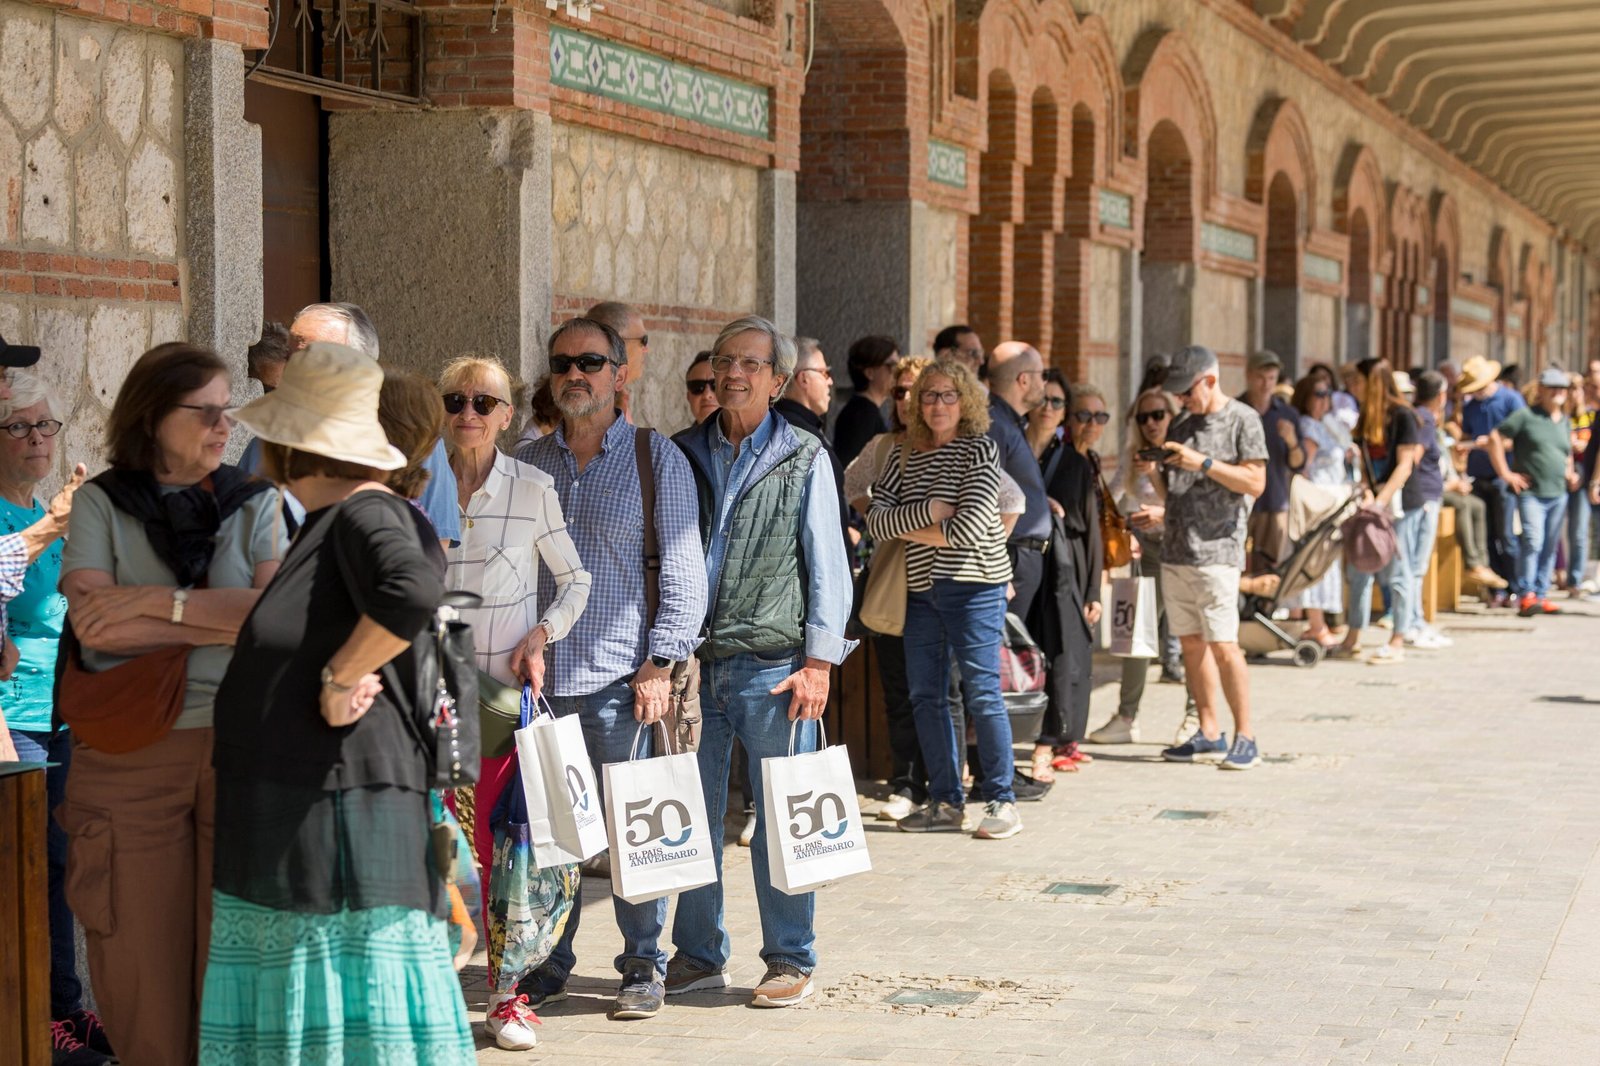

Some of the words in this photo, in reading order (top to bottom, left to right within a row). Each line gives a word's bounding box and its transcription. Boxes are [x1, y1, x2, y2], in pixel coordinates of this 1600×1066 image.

[1114, 600, 1136, 632] 50
[625, 796, 693, 847] 50
[787, 790, 848, 840] 50
[628, 852, 641, 861] EL
[630, 848, 698, 867] ANIVERSARIO
[793, 845, 804, 853] EL
[795, 840, 855, 860] ANIVERSARIO
